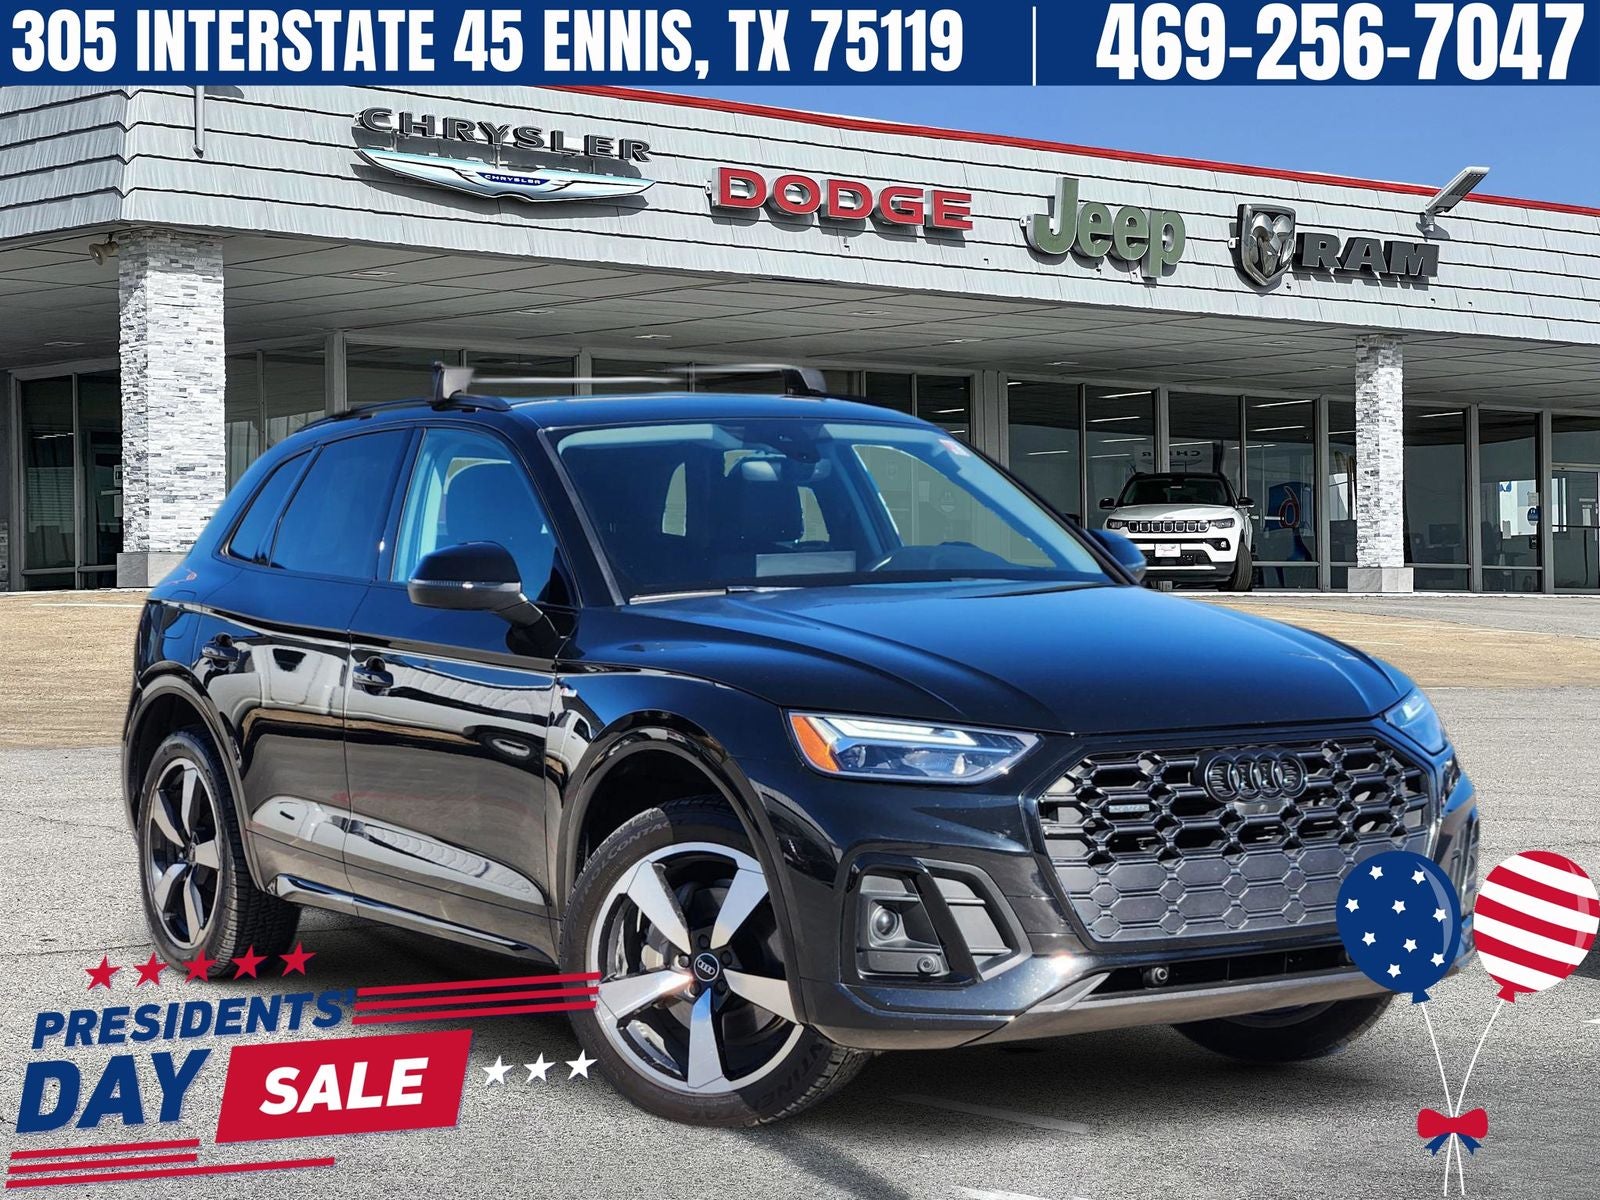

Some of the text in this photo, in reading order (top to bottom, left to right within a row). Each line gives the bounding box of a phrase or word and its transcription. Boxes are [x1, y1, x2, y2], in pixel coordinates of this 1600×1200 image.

[359, 107, 651, 162] CHRYSLER
[484, 174, 541, 185] CHRYSLER
[712, 167, 973, 231] DODGE
[1029, 177, 1186, 278] Jeep
[1298, 232, 1440, 278] RAM
